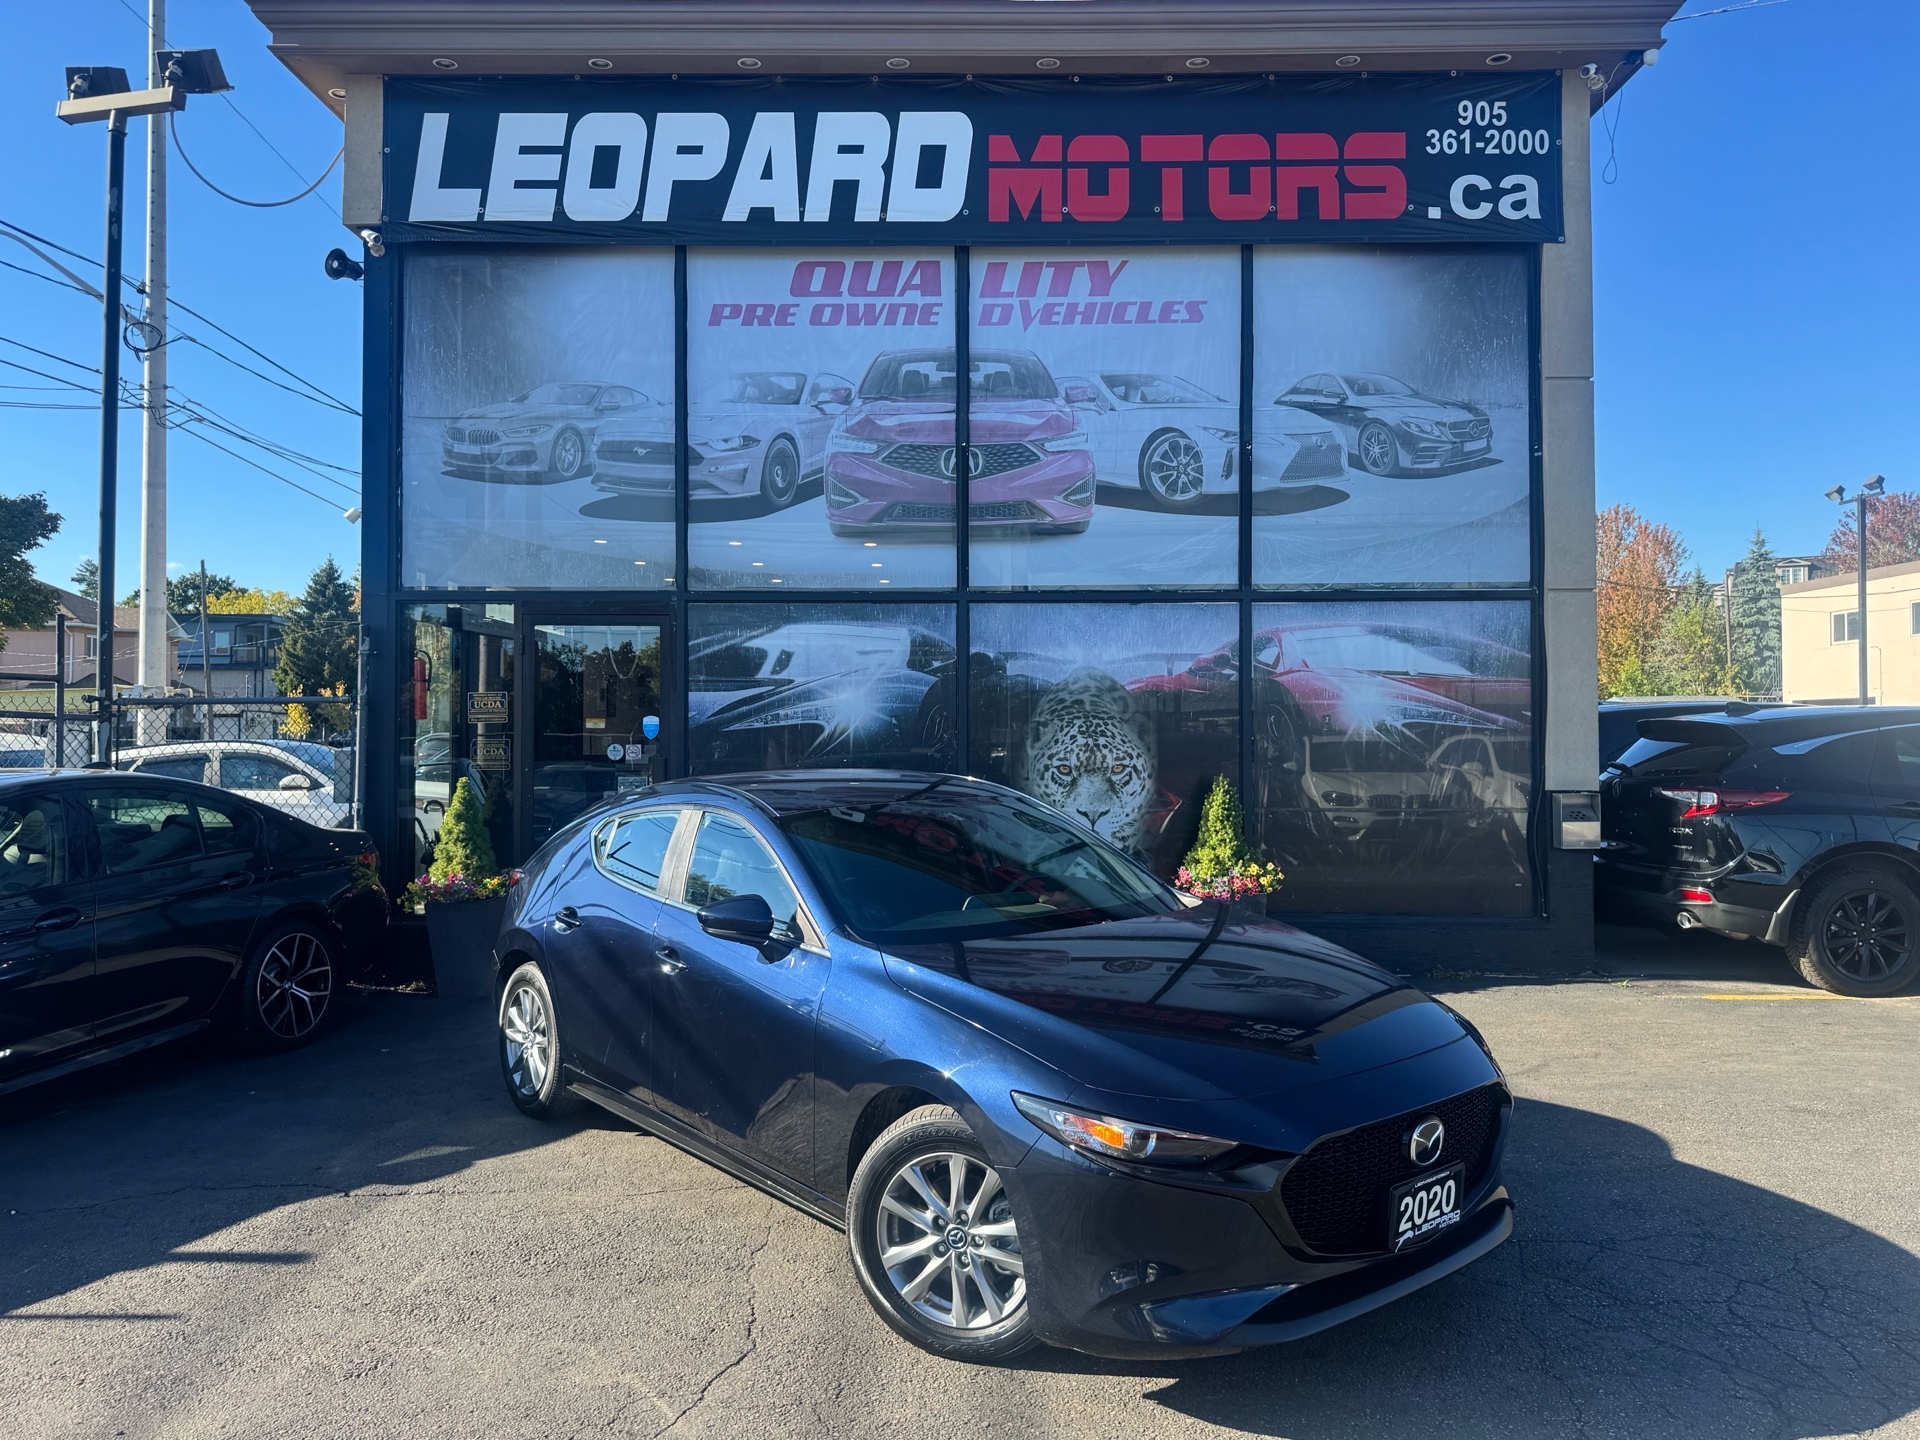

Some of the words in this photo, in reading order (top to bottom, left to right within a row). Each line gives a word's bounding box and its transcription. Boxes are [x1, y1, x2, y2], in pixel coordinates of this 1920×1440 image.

[1457, 100, 1507, 126] 905
[1425, 129, 1550, 154] 361-2000
[408, 112, 973, 222] LEOPARD
[988, 132, 1408, 223] MOTORS
[707, 303, 800, 327] PRE
[474, 700, 502, 709] UCDA
[477, 747, 504, 755] UCDA
[1399, 1180, 1456, 1233] 2020
[1415, 1210, 1460, 1235] LEOPARD
[1439, 1217, 1460, 1228] MOTORS
